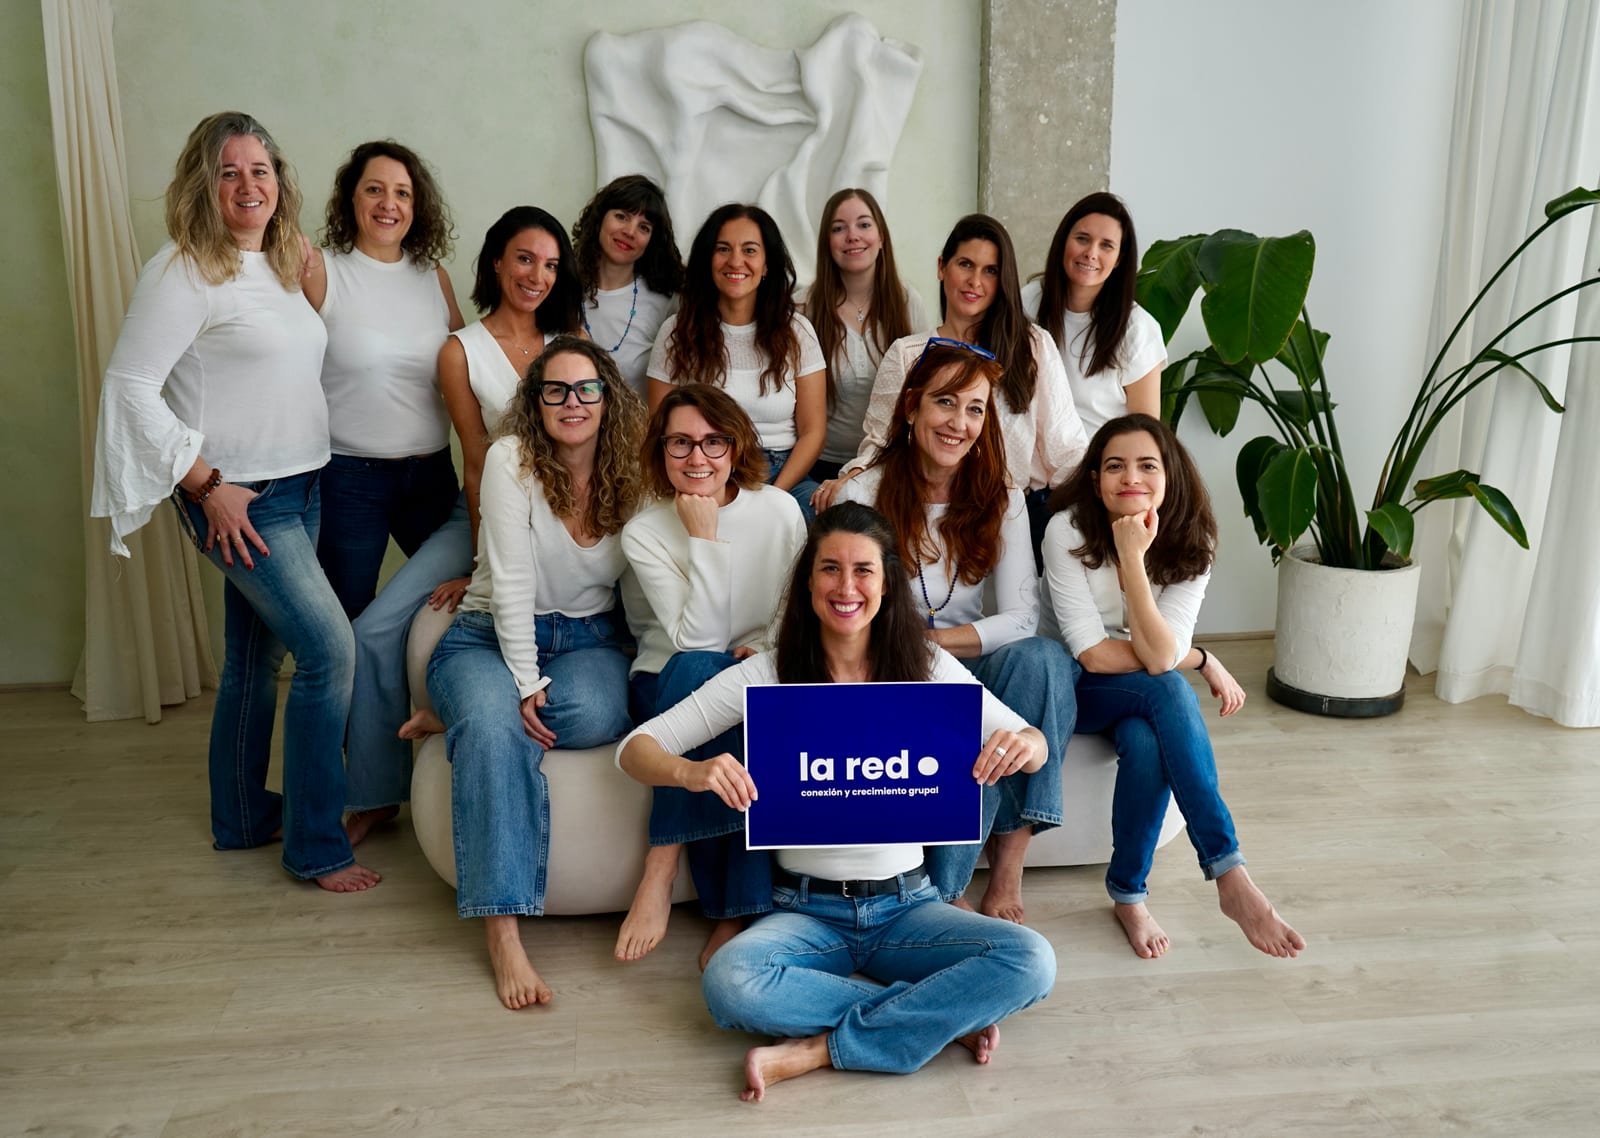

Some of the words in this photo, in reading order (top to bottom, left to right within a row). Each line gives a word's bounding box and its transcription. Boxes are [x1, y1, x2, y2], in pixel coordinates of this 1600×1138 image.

[800, 751, 835, 781] la
[846, 749, 909, 780] red
[800, 787, 843, 797] conexión
[843, 789, 851, 798] y
[851, 786, 907, 796] crecimiento
[908, 786, 939, 797] grupal
